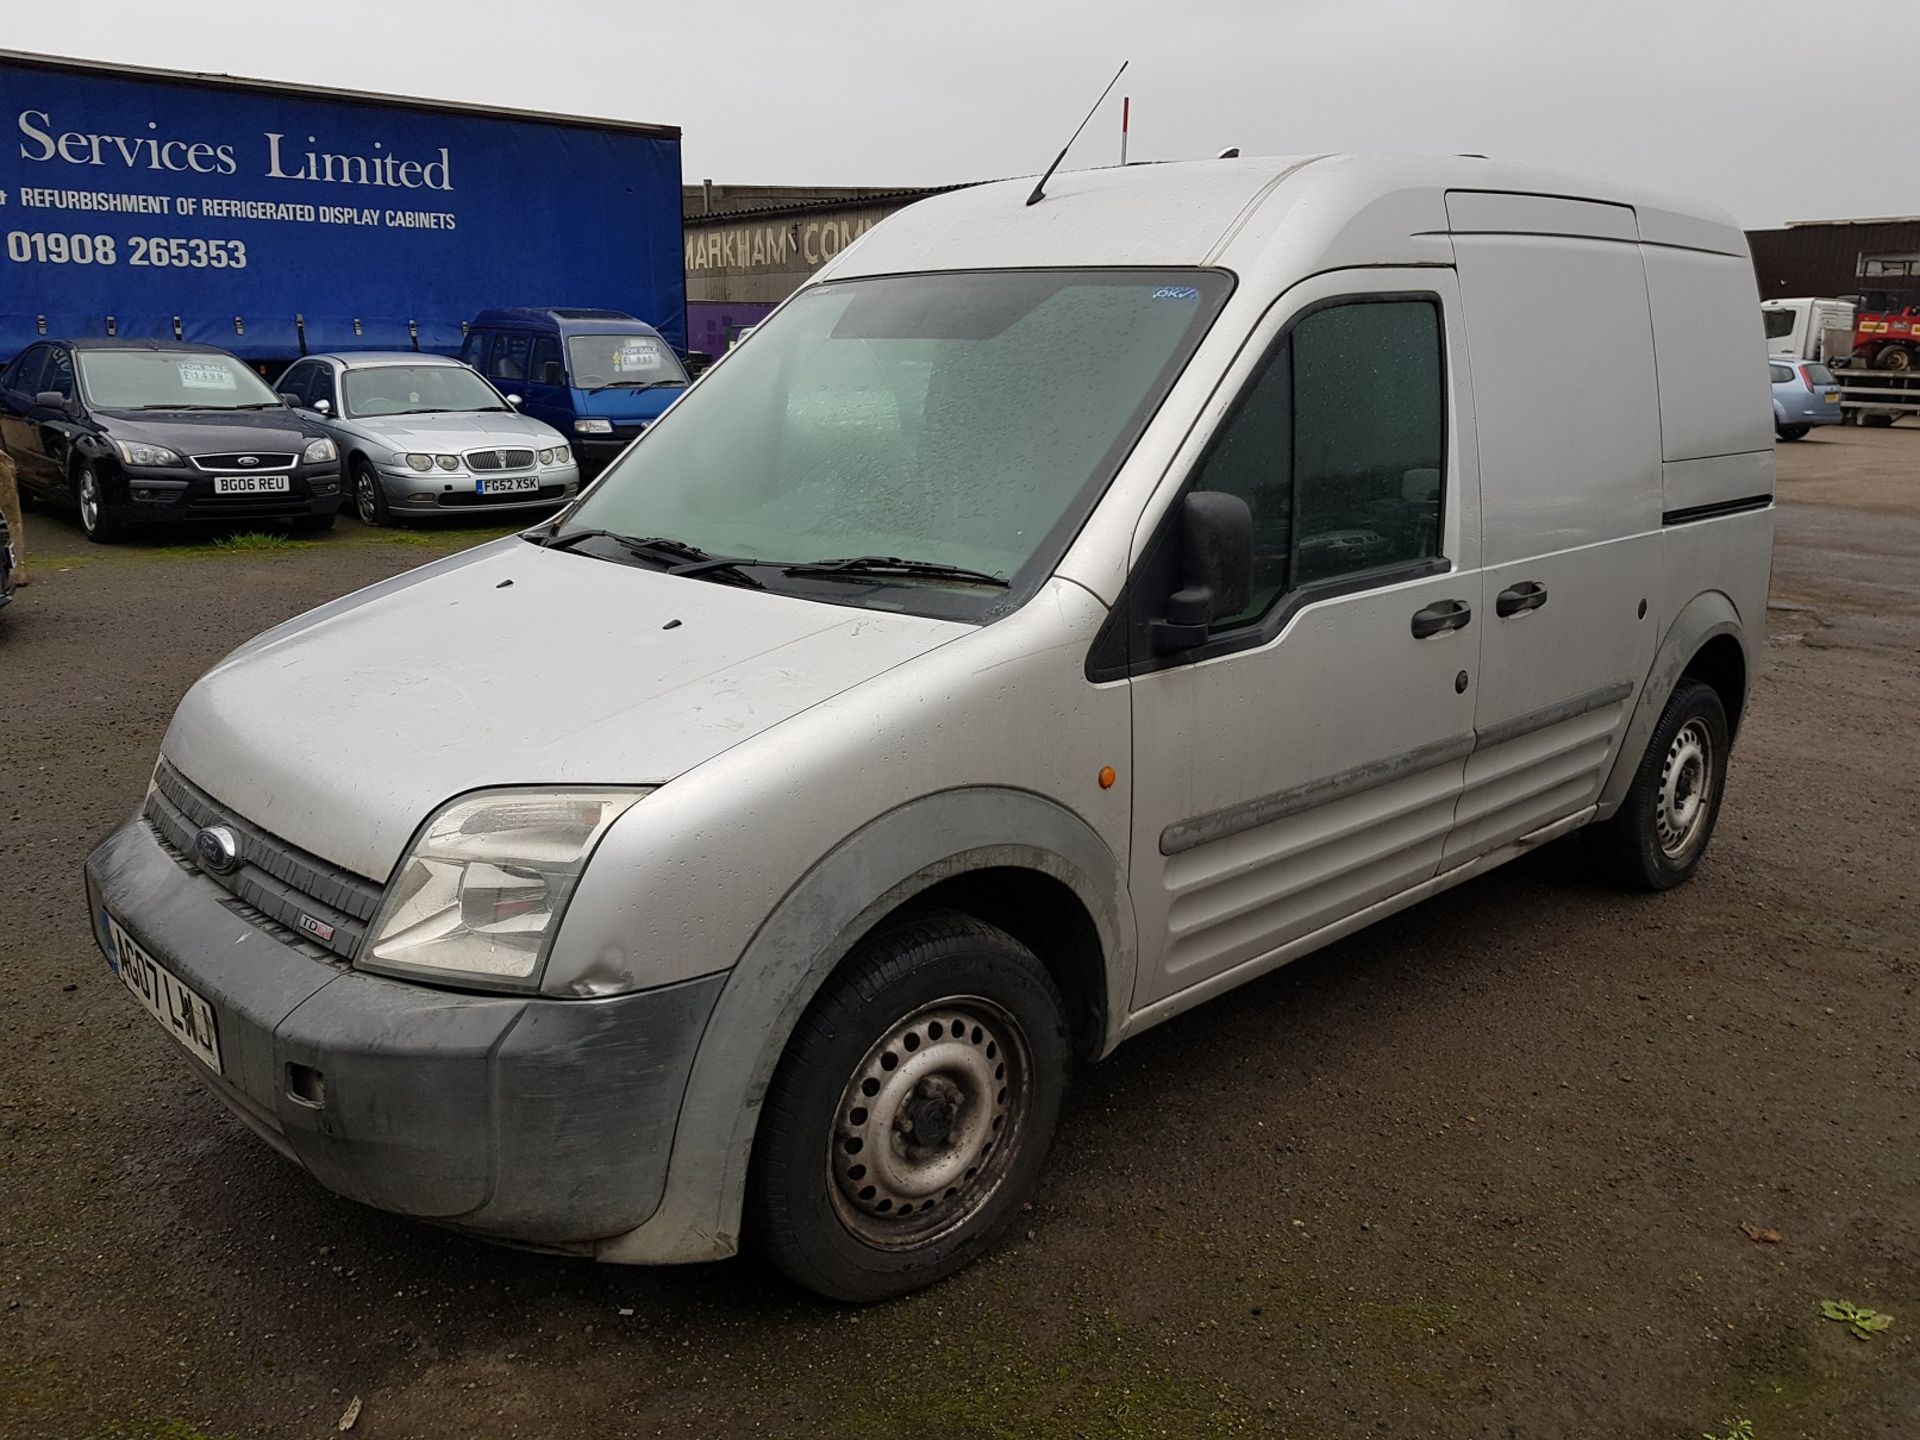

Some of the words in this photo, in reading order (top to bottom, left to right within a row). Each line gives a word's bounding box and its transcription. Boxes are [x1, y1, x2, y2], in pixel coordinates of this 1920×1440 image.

[18, 110, 237, 175] Services
[264, 132, 454, 190] Limited
[20, 187, 171, 214] REFURBISHMENT
[176, 197, 197, 216] OF
[202, 199, 316, 223] REFRIGERATED
[319, 205, 381, 226] DISPLAY
[385, 210, 456, 230] CABINETS
[7, 231, 117, 265] 01908
[127, 237, 247, 269] 265353
[220, 478, 256, 491] BG06
[258, 477, 284, 490] REU
[484, 480, 514, 492] FG52
[516, 478, 537, 489] XSK
[115, 928, 160, 1010] AG07
